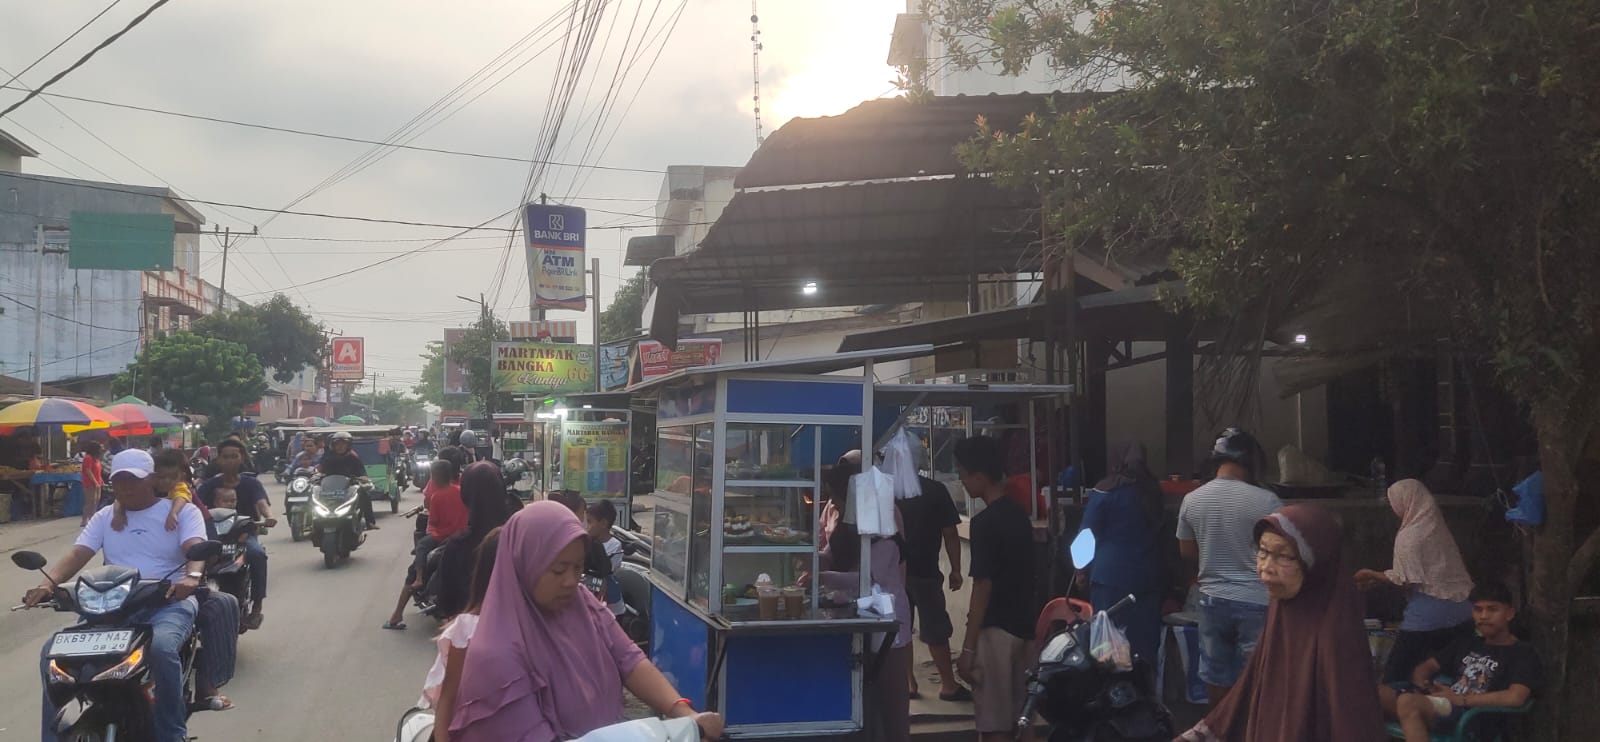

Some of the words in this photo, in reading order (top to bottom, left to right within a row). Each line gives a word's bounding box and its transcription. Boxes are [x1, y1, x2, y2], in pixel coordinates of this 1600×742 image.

[534, 230, 561, 240] BANK
[563, 232, 579, 241] BRI
[543, 255, 575, 267] ATM
[497, 347, 574, 361] MARTABAK
[497, 360, 554, 373] BANGKA
[107, 631, 129, 641] NAZ
